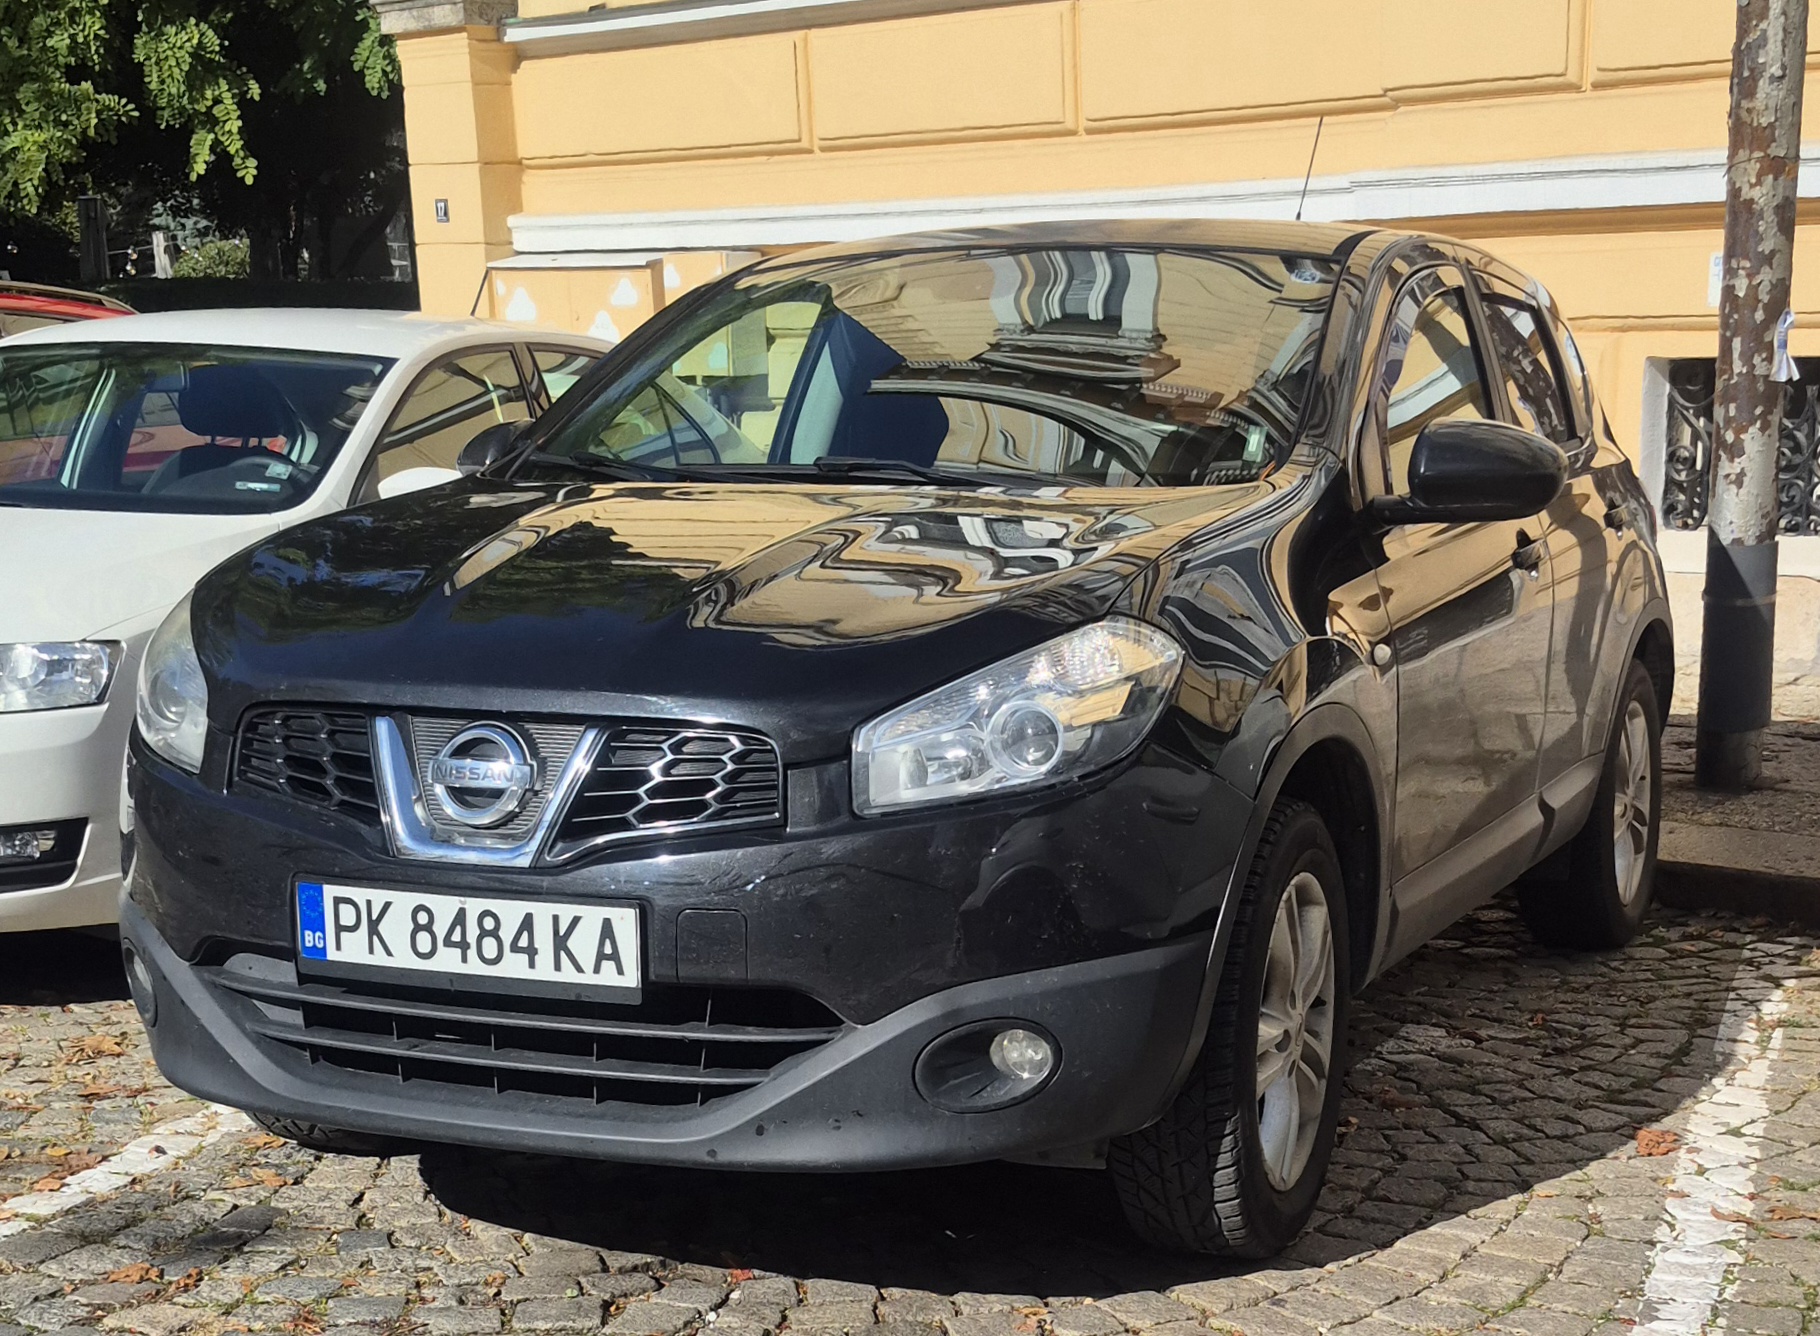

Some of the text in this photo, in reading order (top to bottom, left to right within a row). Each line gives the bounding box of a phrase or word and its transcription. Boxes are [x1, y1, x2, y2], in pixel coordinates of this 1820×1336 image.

[433, 762, 515, 783] NISSAN
[304, 929, 325, 949] BG
[332, 895, 626, 977] PK 8484 KA
